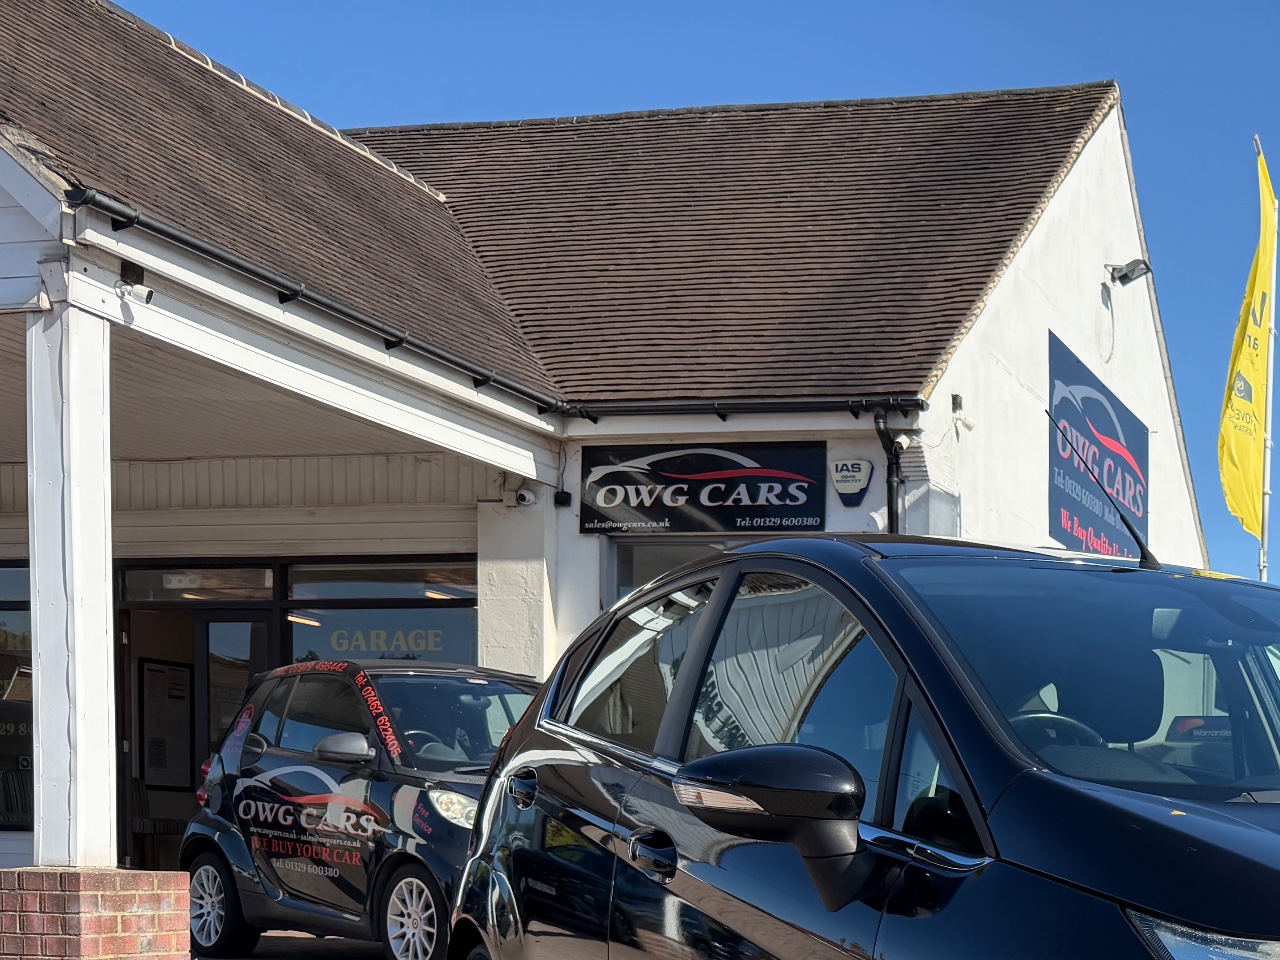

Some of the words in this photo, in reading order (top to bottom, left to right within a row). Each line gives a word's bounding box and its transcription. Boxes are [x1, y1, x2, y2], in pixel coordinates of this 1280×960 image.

[835, 463, 862, 474] IAS
[1057, 418, 1099, 482] OWG
[1103, 457, 1144, 518] CARS
[596, 484, 689, 508] OWG
[700, 482, 809, 507] CARS
[584, 518, 671, 531] sales@owgcars.co.uk
[735, 517, 752, 527] Tel:
[753, 517, 780, 527] 01329
[782, 517, 820, 526] 600380
[1061, 508, 1073, 532] We
[1073, 516, 1087, 552] Buy
[330, 629, 443, 652] GARAGE
[354, 670, 368, 689] Tel:
[361, 686, 384, 716] 07462
[376, 715, 402, 758] 622405
[239, 800, 295, 827] OWG
[300, 806, 375, 838] CARS
[249, 835, 269, 852] WE
[271, 840, 294, 855] BUY
[295, 842, 332, 861] YOUR
[333, 848, 362, 866] CAR
[285, 859, 307, 873] 01329
[307, 863, 340, 878] 600380
